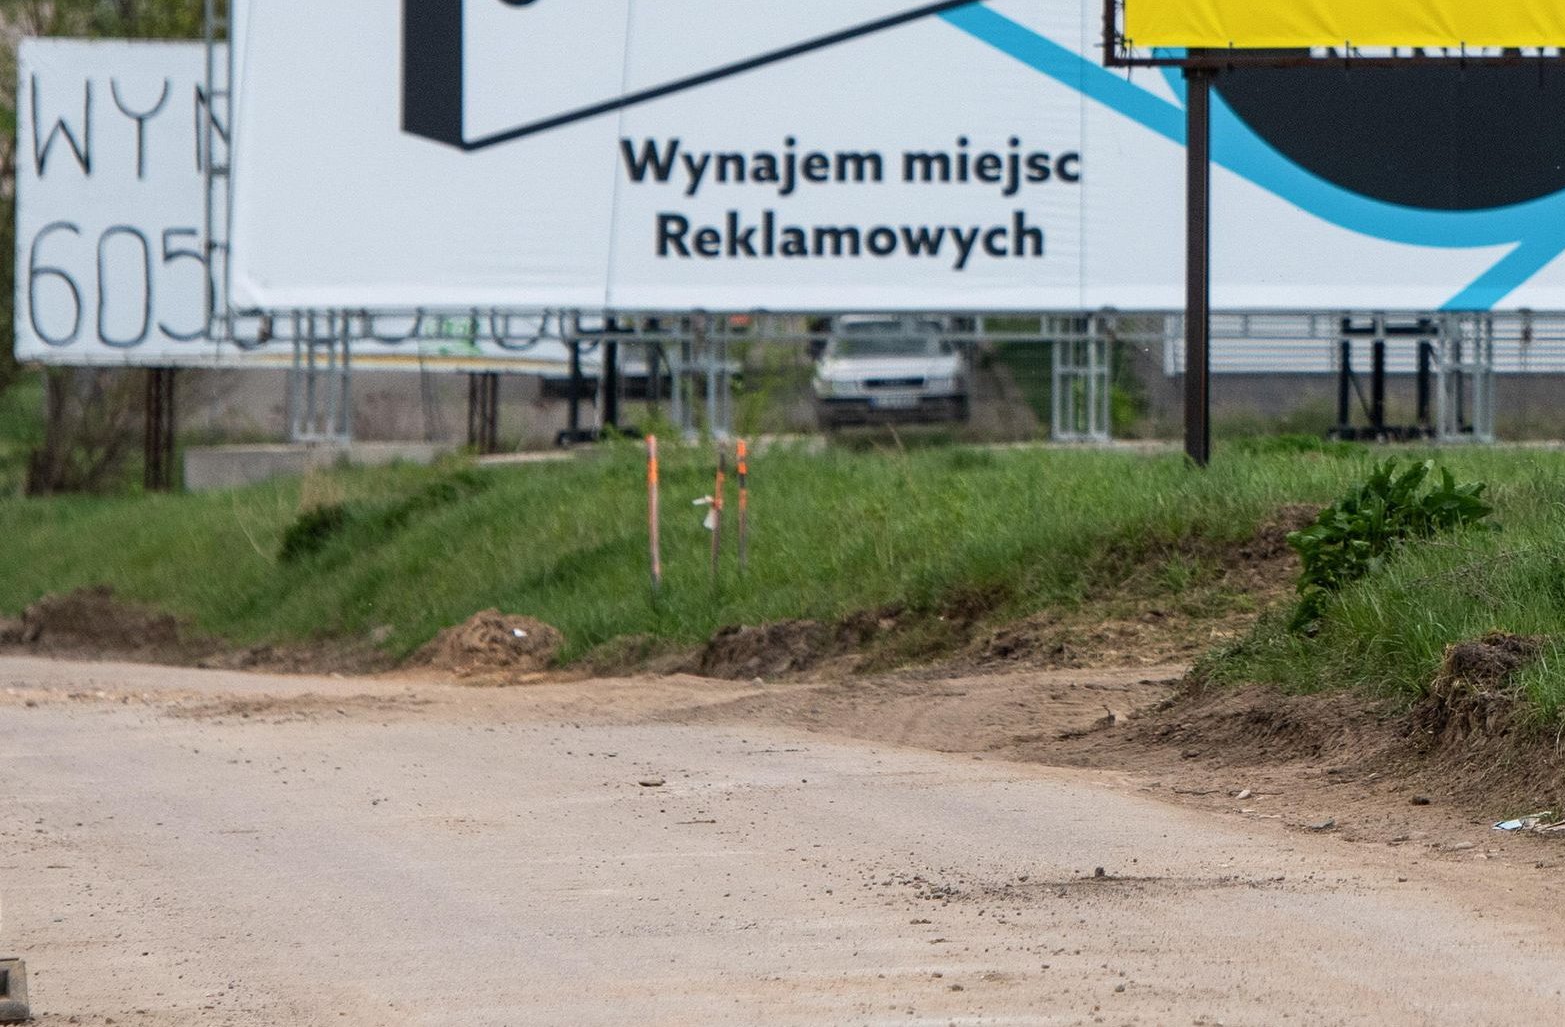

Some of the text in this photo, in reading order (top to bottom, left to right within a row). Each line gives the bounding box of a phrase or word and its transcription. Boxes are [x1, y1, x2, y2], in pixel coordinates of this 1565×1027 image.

[619, 136, 1081, 198] Wynajem miejsc
[656, 209, 1044, 271] Reklamowych
